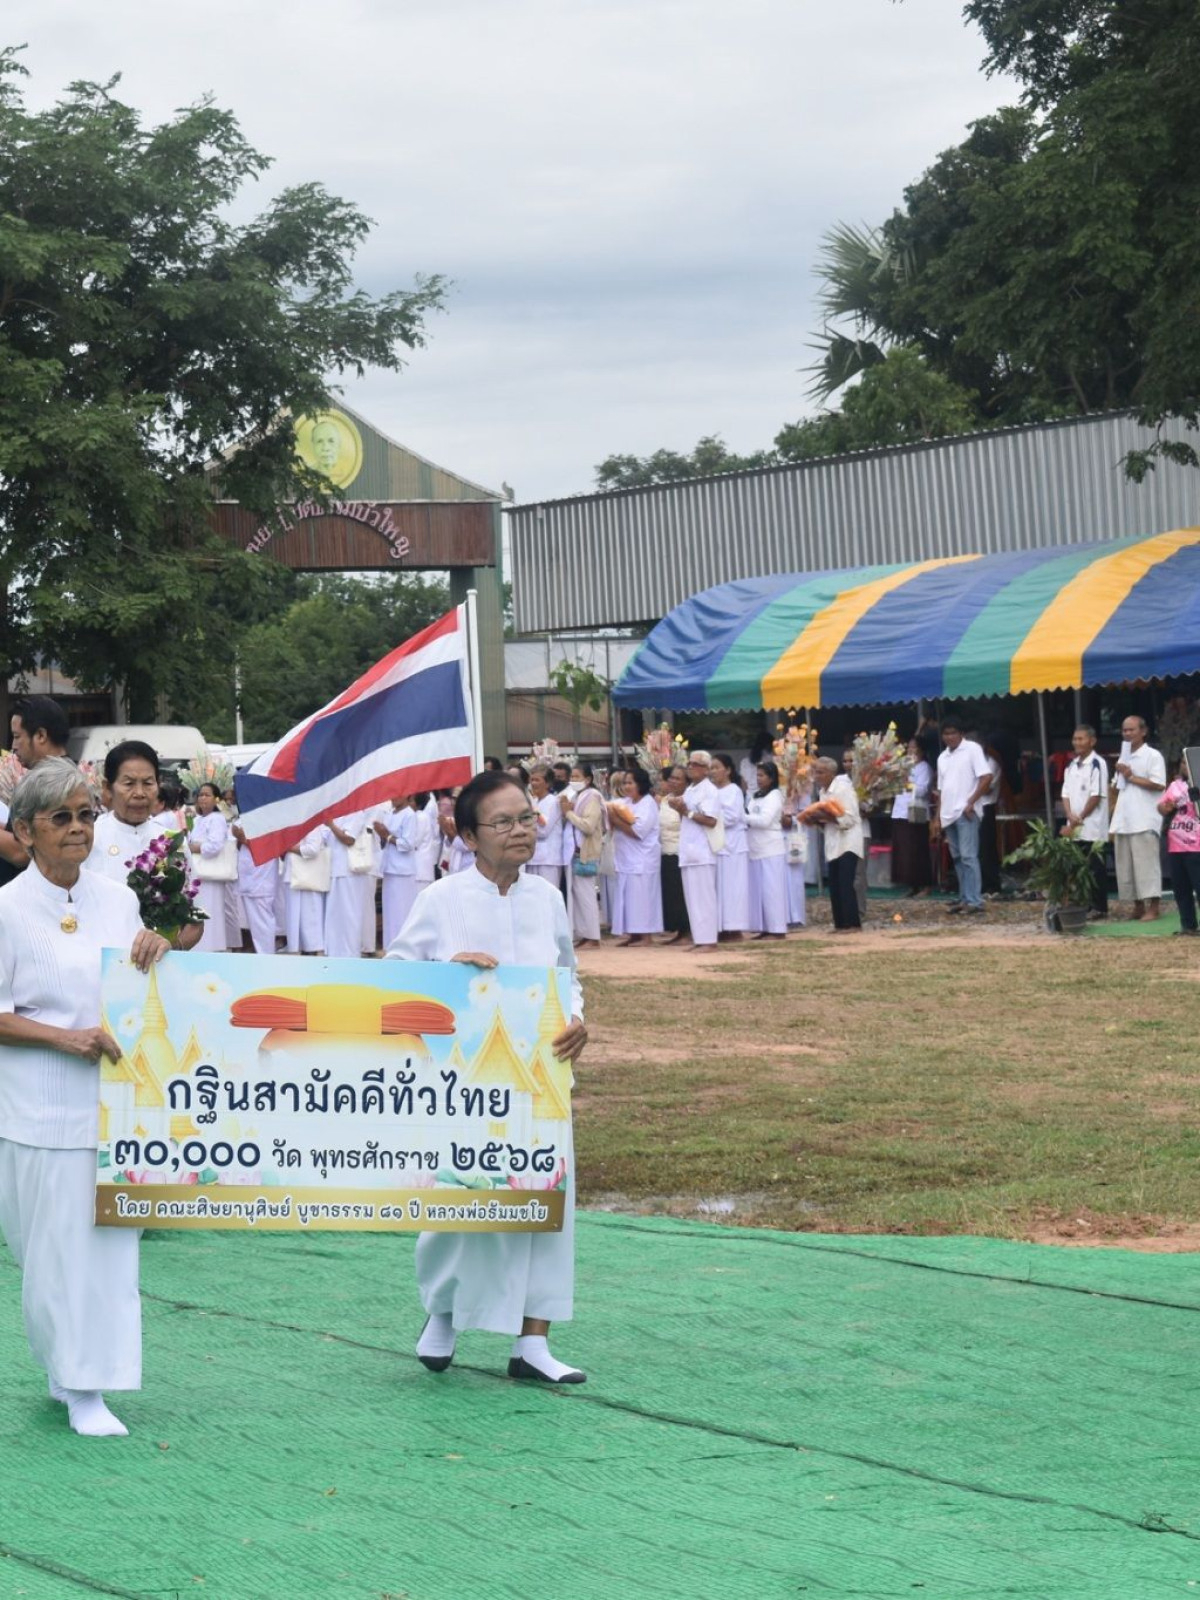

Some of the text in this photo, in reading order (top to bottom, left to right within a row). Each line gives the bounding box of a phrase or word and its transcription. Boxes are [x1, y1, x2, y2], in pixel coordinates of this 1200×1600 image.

[167, 1057, 511, 1124] กฐินสามัคคีทั่วไทย
[114, 1138, 556, 1179] ๓๐,๐๐๐ วัด พุทธศักราช ๒๕๖๘
[116, 1195, 548, 1224] โดย คณะศิษยานุศิษย์ บูชาธรรม ๘๑ ปี หลวงพ่อธัมมชโย
